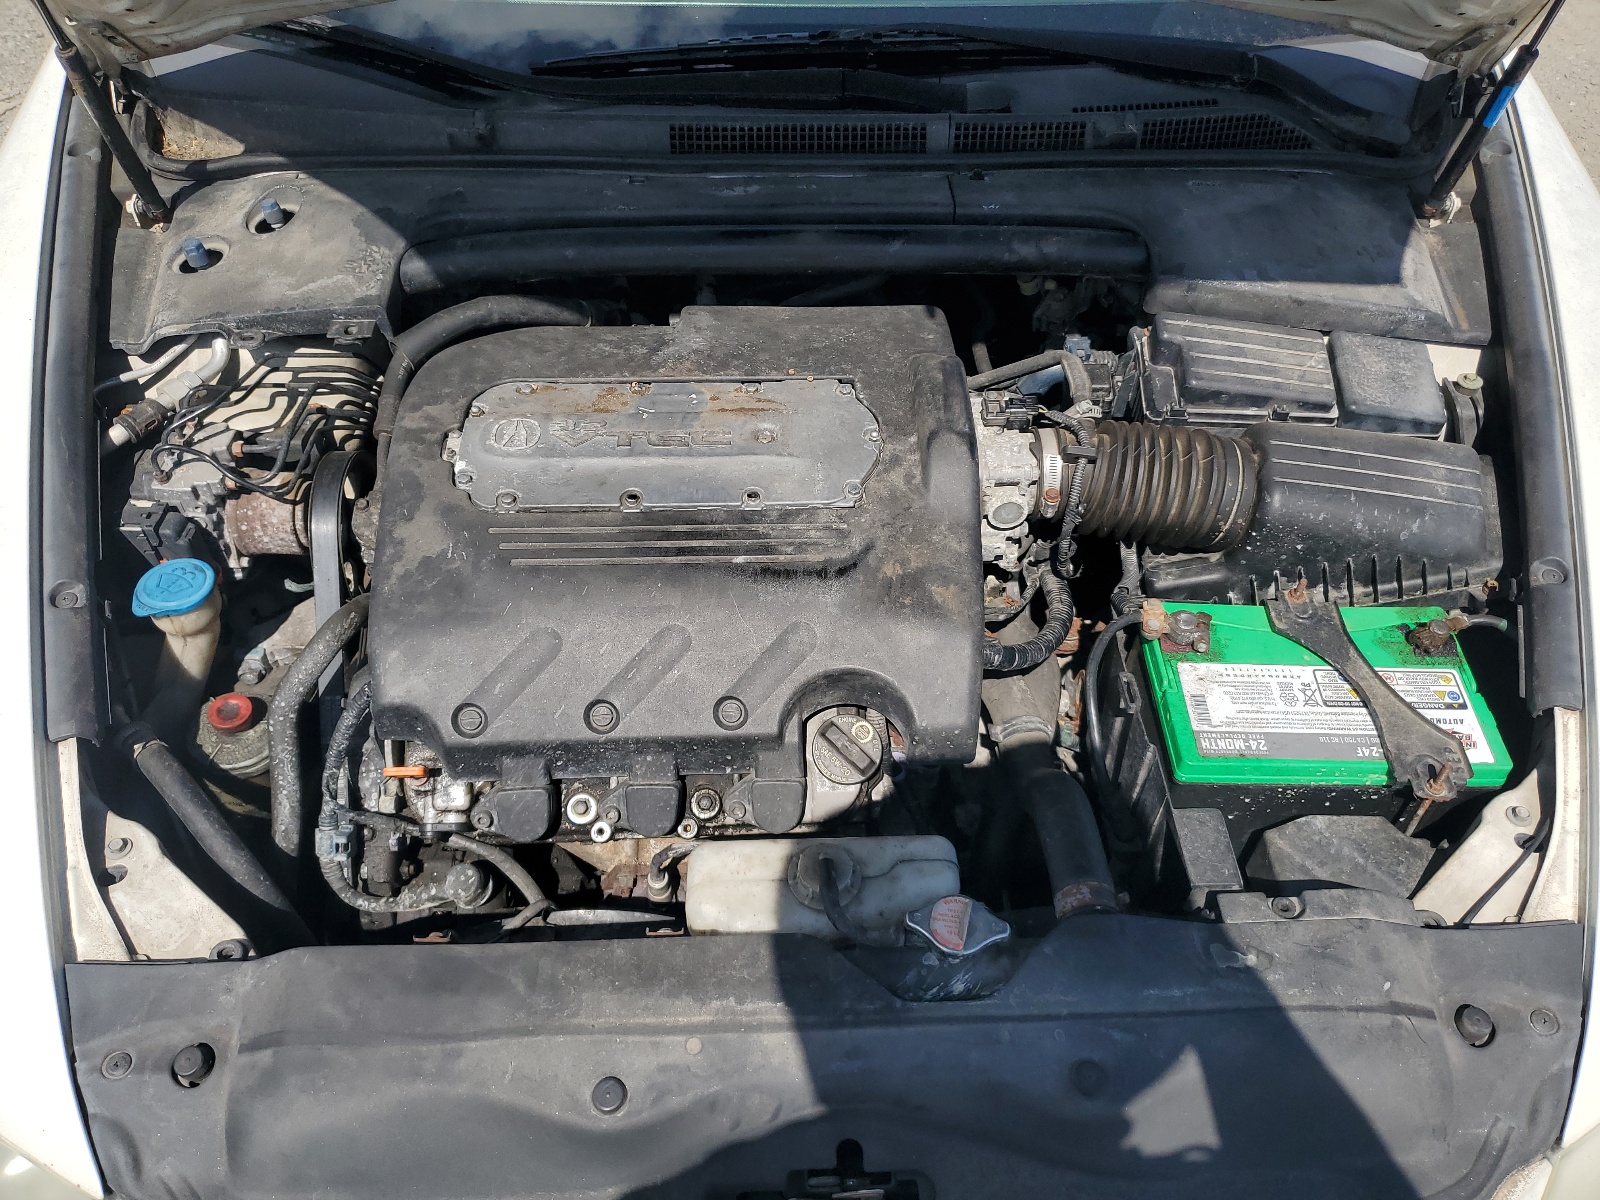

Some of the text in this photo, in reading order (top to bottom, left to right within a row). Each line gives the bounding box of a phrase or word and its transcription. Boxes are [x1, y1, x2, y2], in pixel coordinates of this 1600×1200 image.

[1201, 739, 1266, 751] 24-MONTH
[820, 746, 833, 759] SAE
[830, 755, 851, 776] 5W-20
